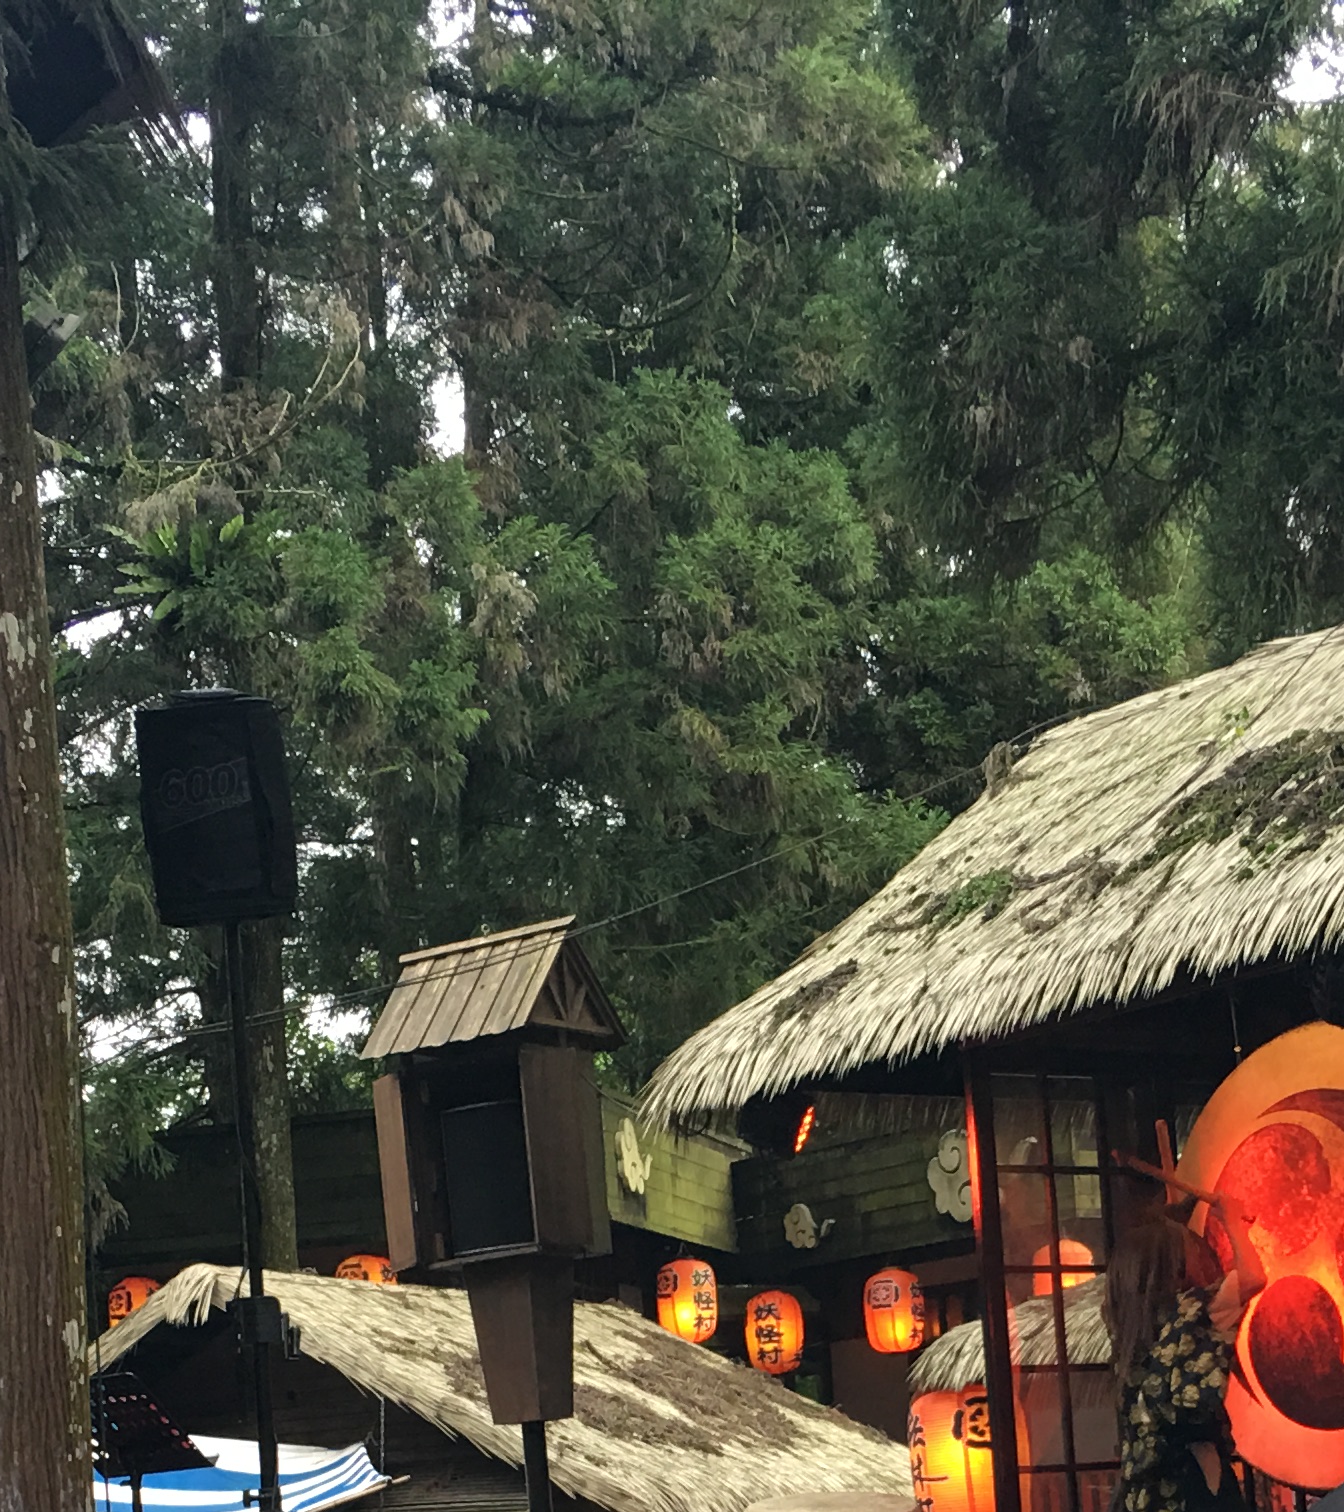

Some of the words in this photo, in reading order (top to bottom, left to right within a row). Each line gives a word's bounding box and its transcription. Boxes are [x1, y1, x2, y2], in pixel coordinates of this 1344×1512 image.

[160, 763, 238, 808] 600
[692, 1269, 715, 1331] 妖怪村
[754, 1303, 782, 1364] 妖怪村
